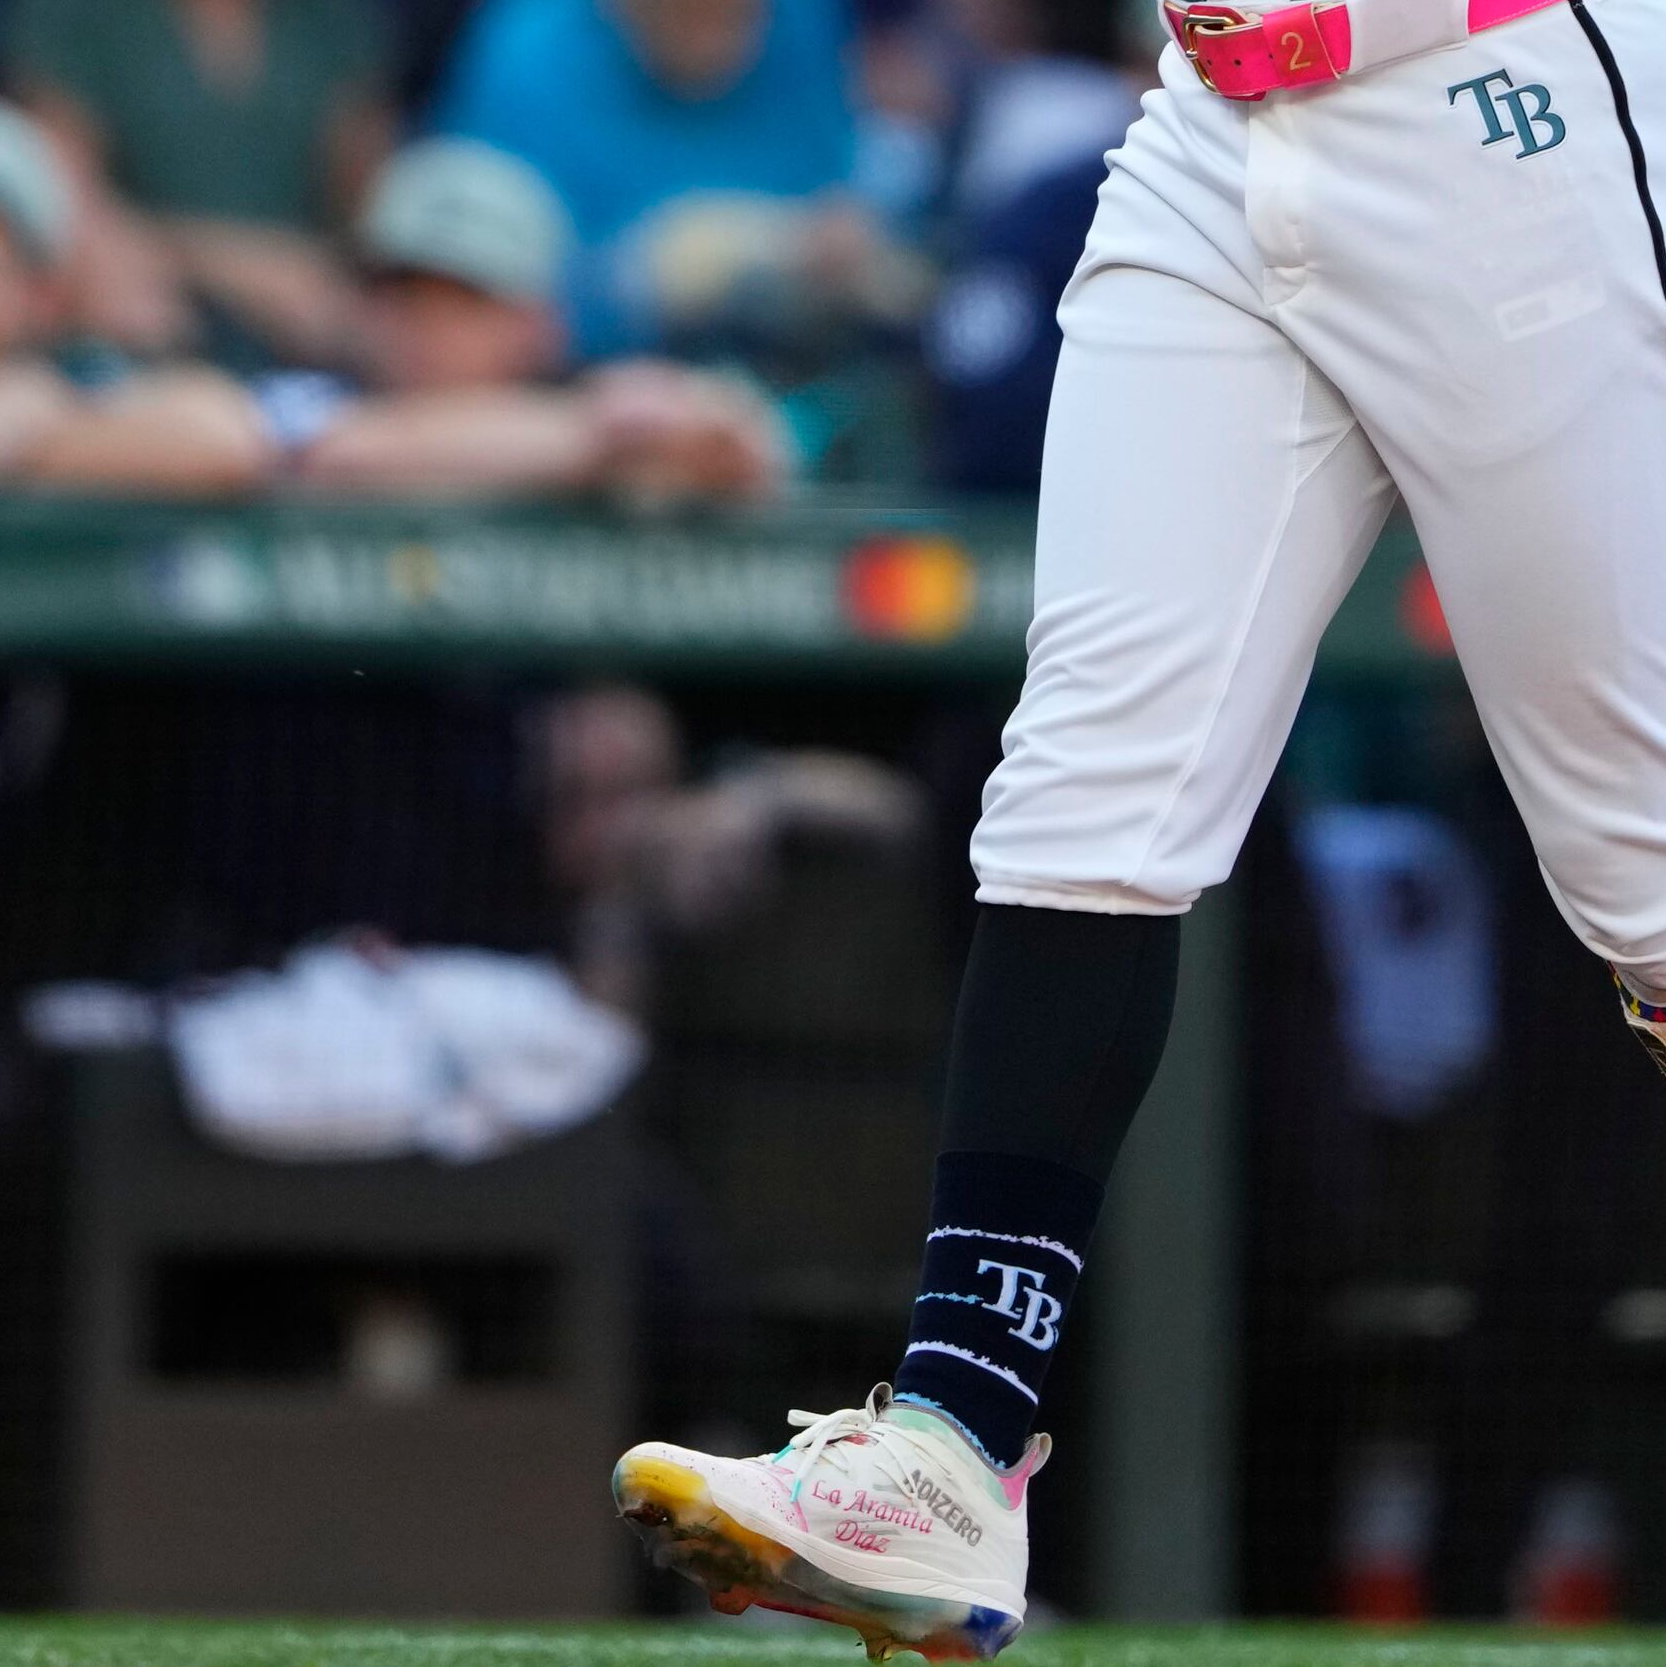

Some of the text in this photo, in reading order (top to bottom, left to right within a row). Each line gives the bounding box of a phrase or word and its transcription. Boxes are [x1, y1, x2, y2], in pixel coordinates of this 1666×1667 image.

[1280, 31, 1312, 72] 2
[1446, 67, 1567, 161] TB
[976, 1258, 1063, 1352] TB
[811, 1479, 843, 1506] La
[903, 1468, 983, 1548] ADIZERO
